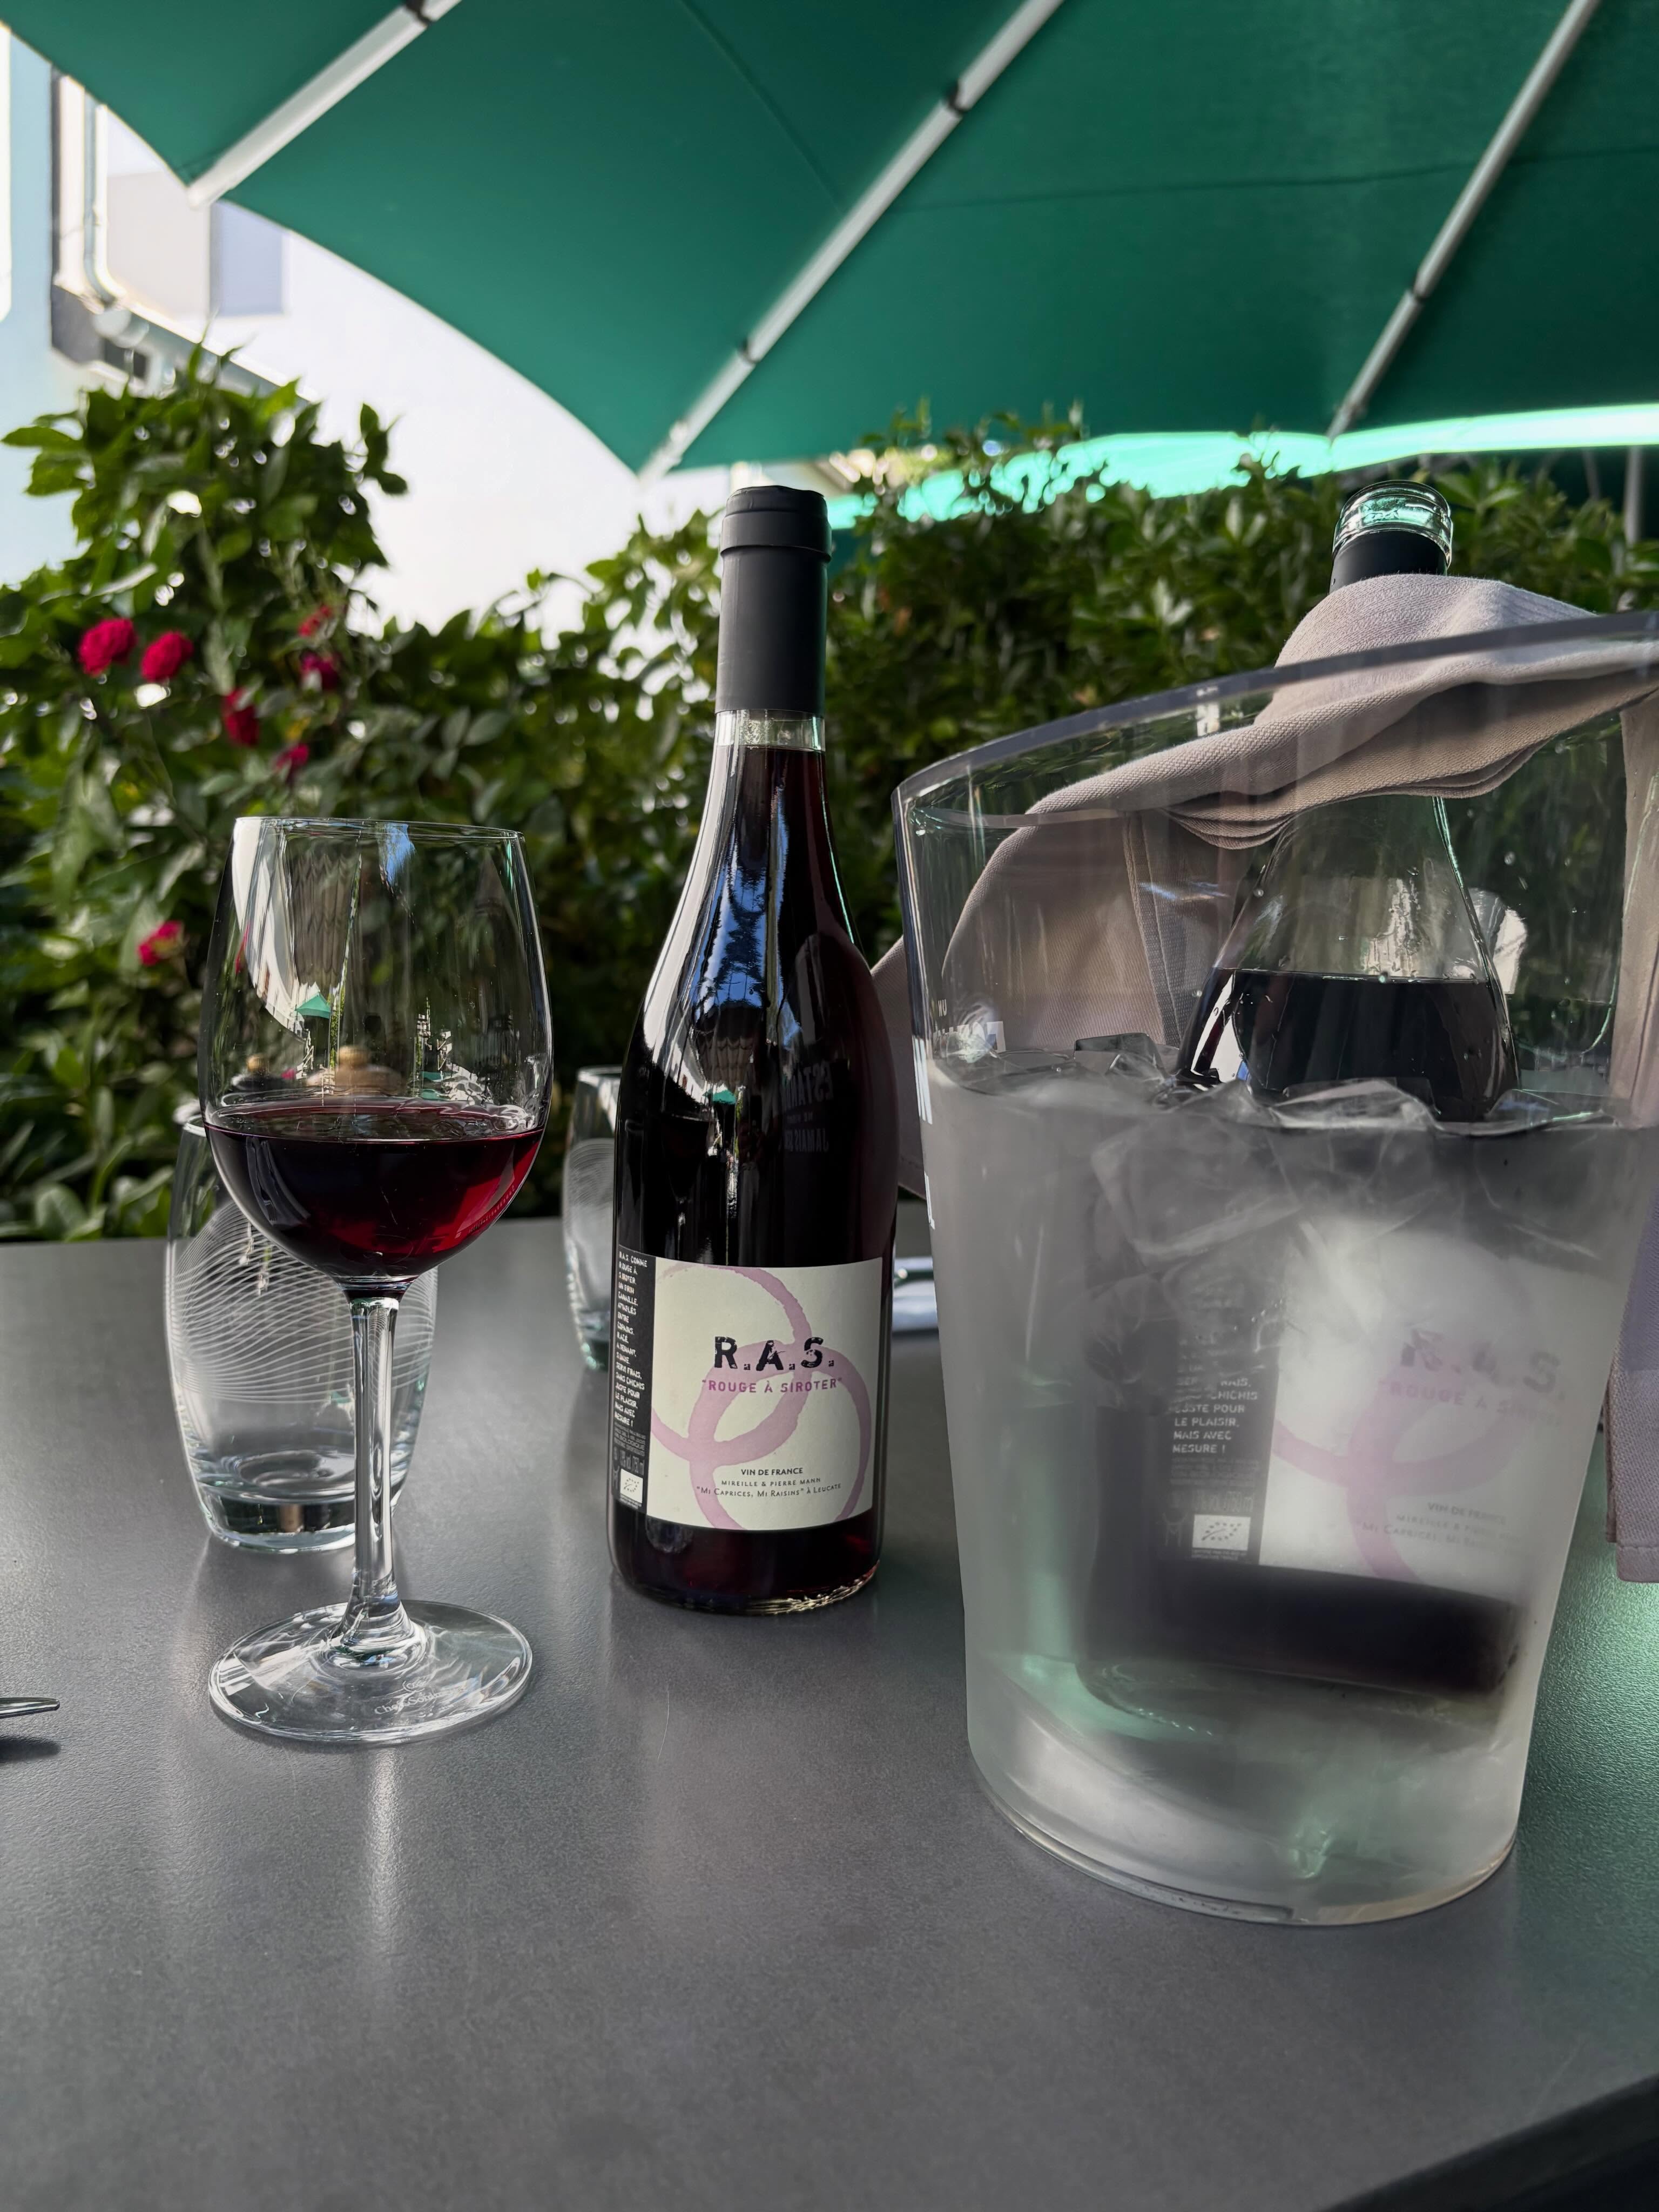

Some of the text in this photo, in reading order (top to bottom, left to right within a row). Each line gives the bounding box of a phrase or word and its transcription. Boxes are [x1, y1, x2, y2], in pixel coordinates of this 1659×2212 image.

[714, 1336, 834, 1371] R.A.S.
[626, 1377, 645, 1390] CHICHIS
[764, 1380, 773, 1393] À
[628, 1388, 640, 1399] POUR
[624, 1408, 635, 1418] AVEC
[1213, 1404, 1245, 1413] POUR
[1174, 1417, 1188, 1426] LE
[1173, 1431, 1232, 1440] MAIS AVEC
[1172, 1444, 1217, 1454] MESURE
[771, 1467, 803, 1475] FRANCE
